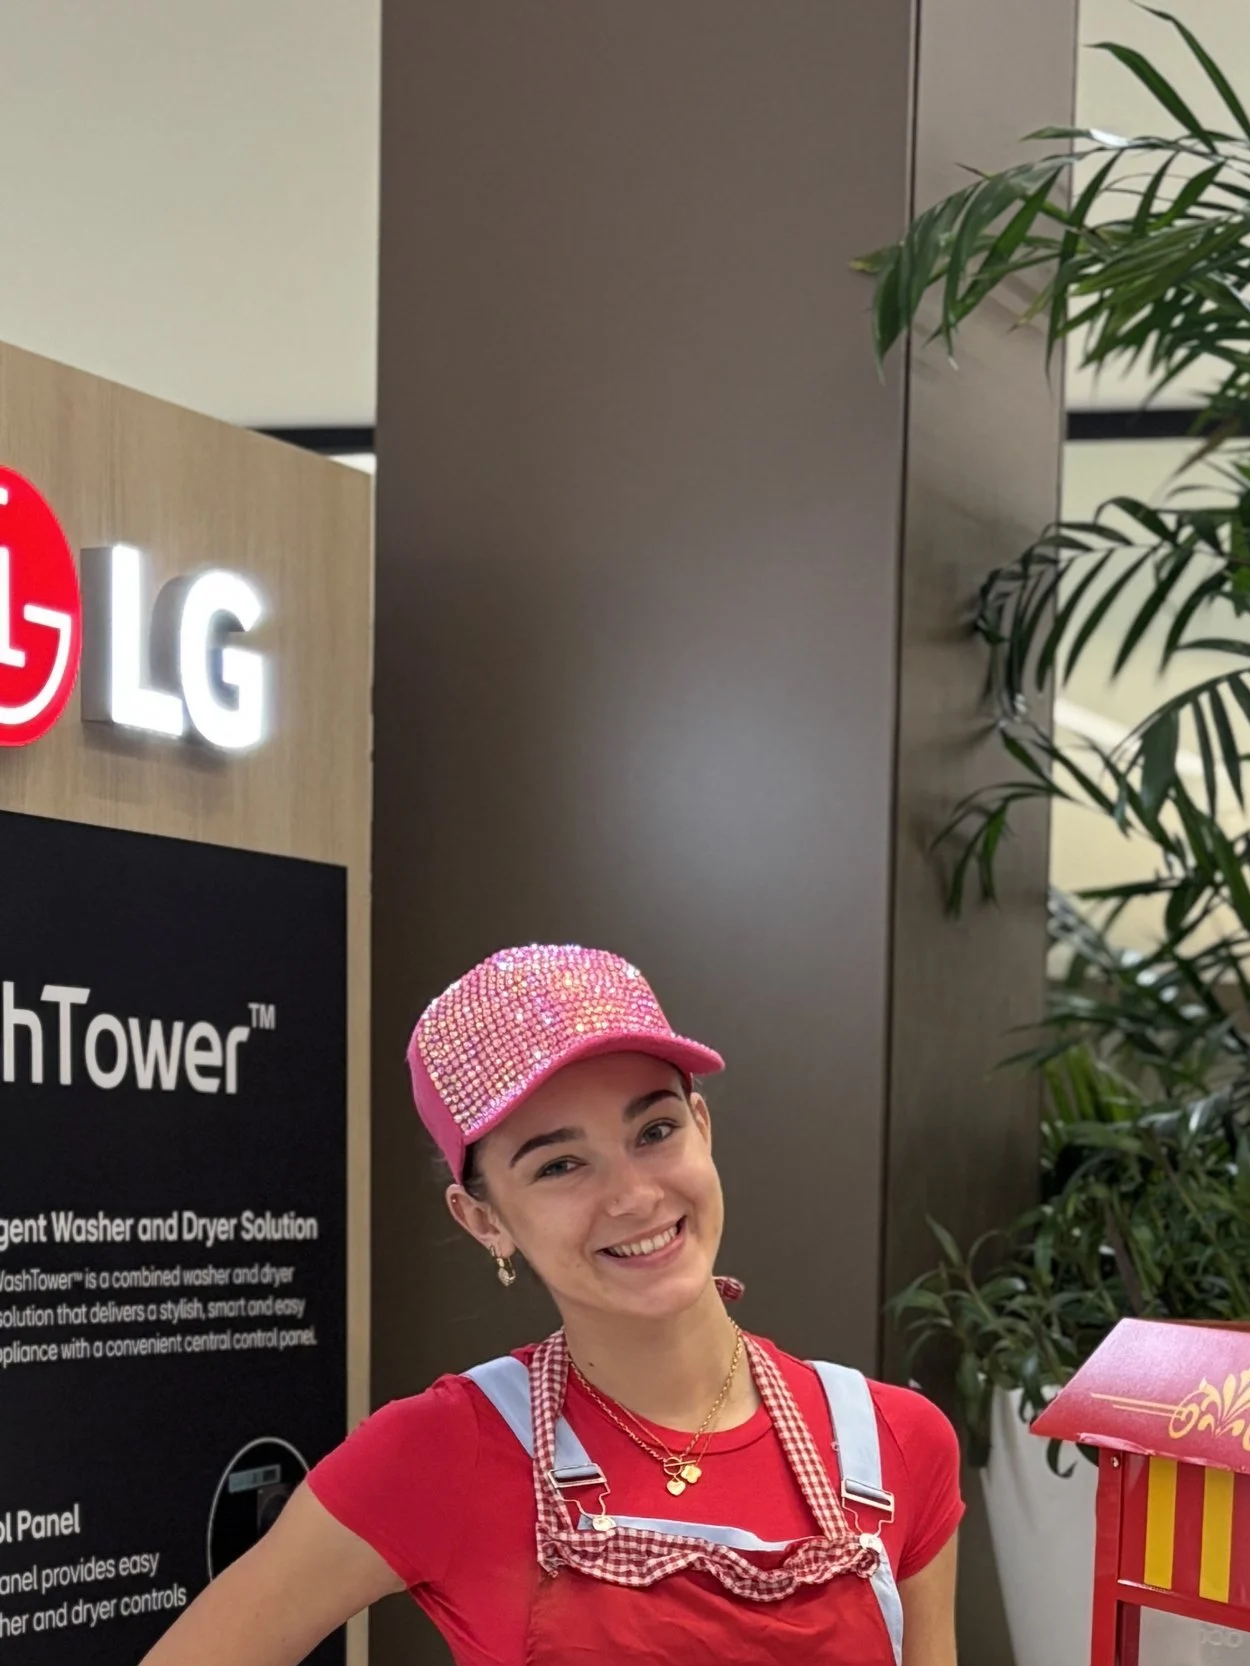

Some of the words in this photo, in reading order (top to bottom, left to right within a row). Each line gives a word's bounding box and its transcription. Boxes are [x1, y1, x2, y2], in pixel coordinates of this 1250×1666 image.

[110, 543, 266, 750] LG
[51, 1210, 134, 1242] Washer
[137, 1210, 178, 1242] and
[182, 1210, 238, 1248] Dryer
[240, 1210, 319, 1241] Solution
[85, 1267, 97, 1290] is
[99, 1271, 109, 1289] a
[112, 1265, 180, 1288] combined
[183, 1264, 230, 1286] washer
[232, 1262, 258, 1284] and
[260, 1262, 295, 1288] dryer
[57, 1303, 87, 1325] that
[90, 1302, 145, 1323] delivers
[147, 1304, 156, 1320] a
[160, 1297, 206, 1324] stylish,
[207, 1298, 246, 1318] smart
[247, 1295, 273, 1316] and
[275, 1296, 306, 1319] easy
[61, 1337, 90, 1360] with
[93, 1341, 102, 1357] a
[105, 1332, 183, 1357] convenient
[184, 1329, 231, 1353] central
[233, 1327, 278, 1349] control
[279, 1324, 317, 1350] panel.
[17, 1503, 81, 1541] Panel
[41, 1556, 115, 1595] provides
[119, 1552, 160, 1577] easy
[33, 1602, 68, 1632] and
[71, 1599, 117, 1628] dryer
[120, 1583, 187, 1616] controls
